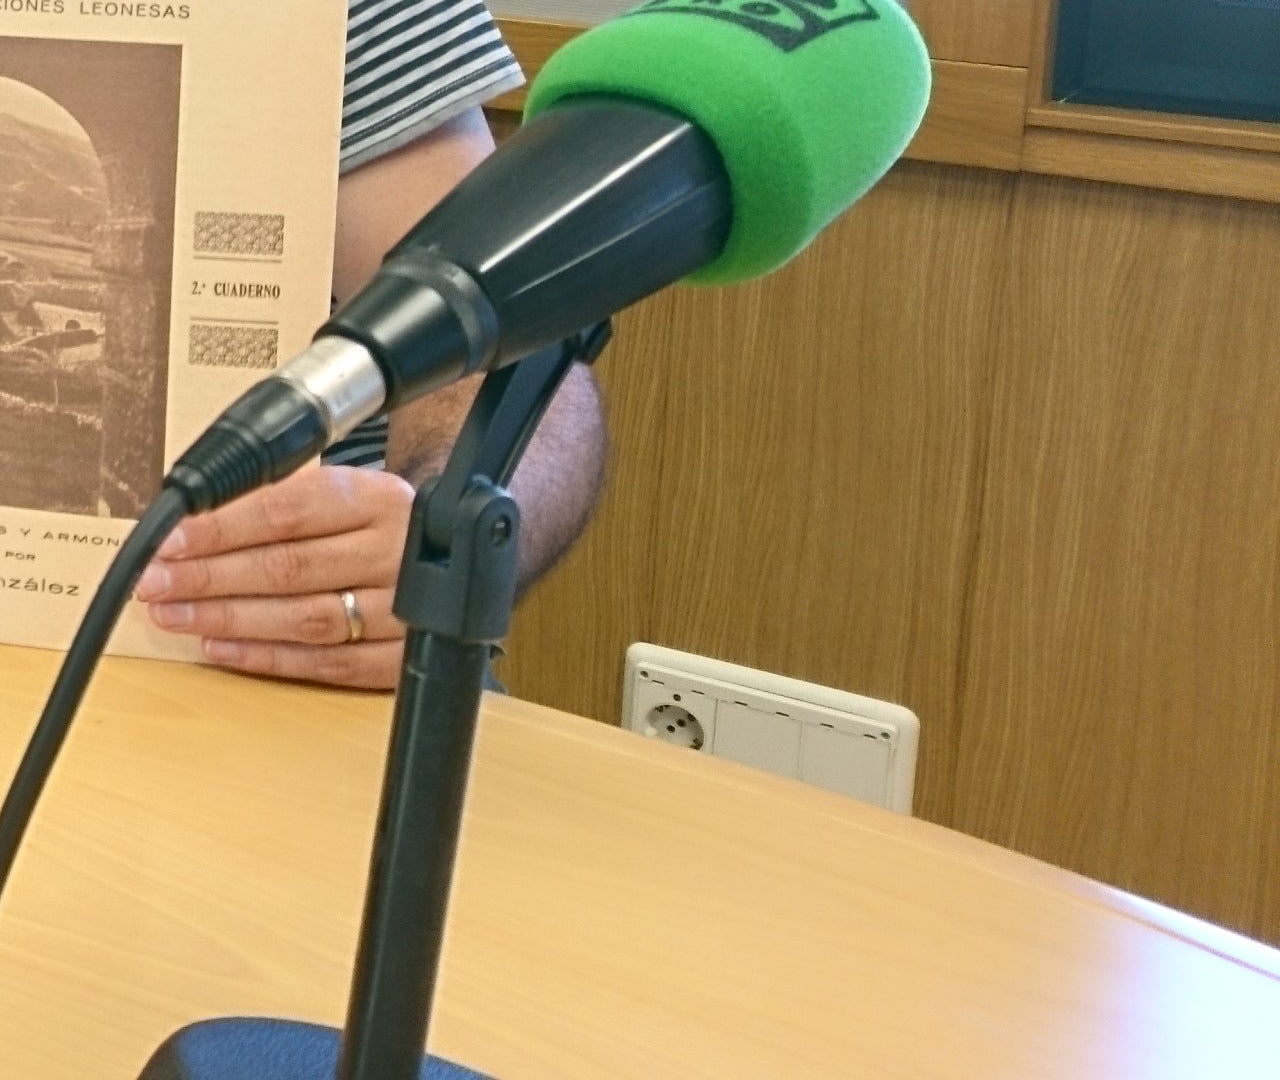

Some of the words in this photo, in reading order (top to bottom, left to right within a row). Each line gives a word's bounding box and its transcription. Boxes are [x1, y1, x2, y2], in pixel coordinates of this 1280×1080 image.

[79, 1, 191, 19] LEONESAS
[213, 281, 281, 300] CUADERNO
[19, 527, 32, 538] Y
[43, 531, 120, 547] ARMON
[5, 550, 37, 562] POR
